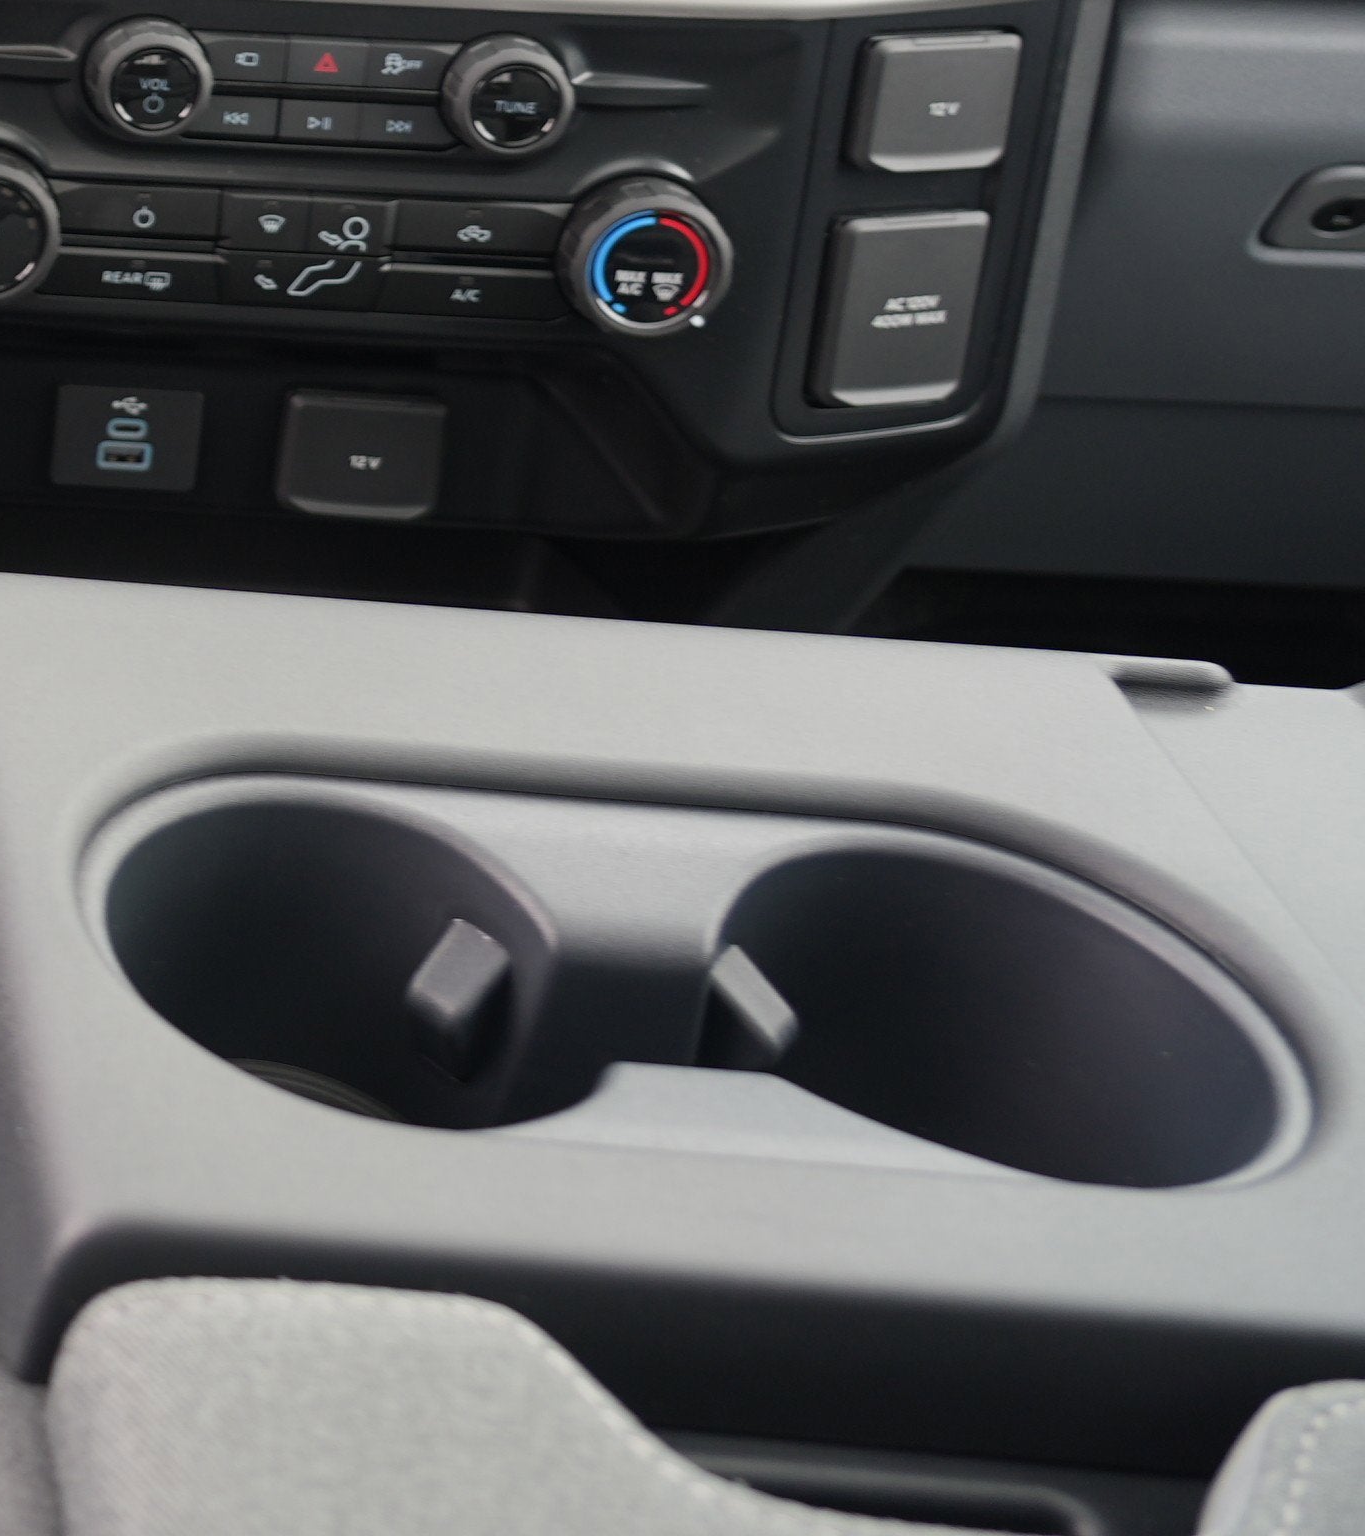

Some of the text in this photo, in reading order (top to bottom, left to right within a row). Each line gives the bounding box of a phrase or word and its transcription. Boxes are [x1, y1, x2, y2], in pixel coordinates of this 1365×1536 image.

[139, 77, 171, 91] VOL
[494, 99, 538, 114] TUNE
[101, 270, 144, 284] REAR
